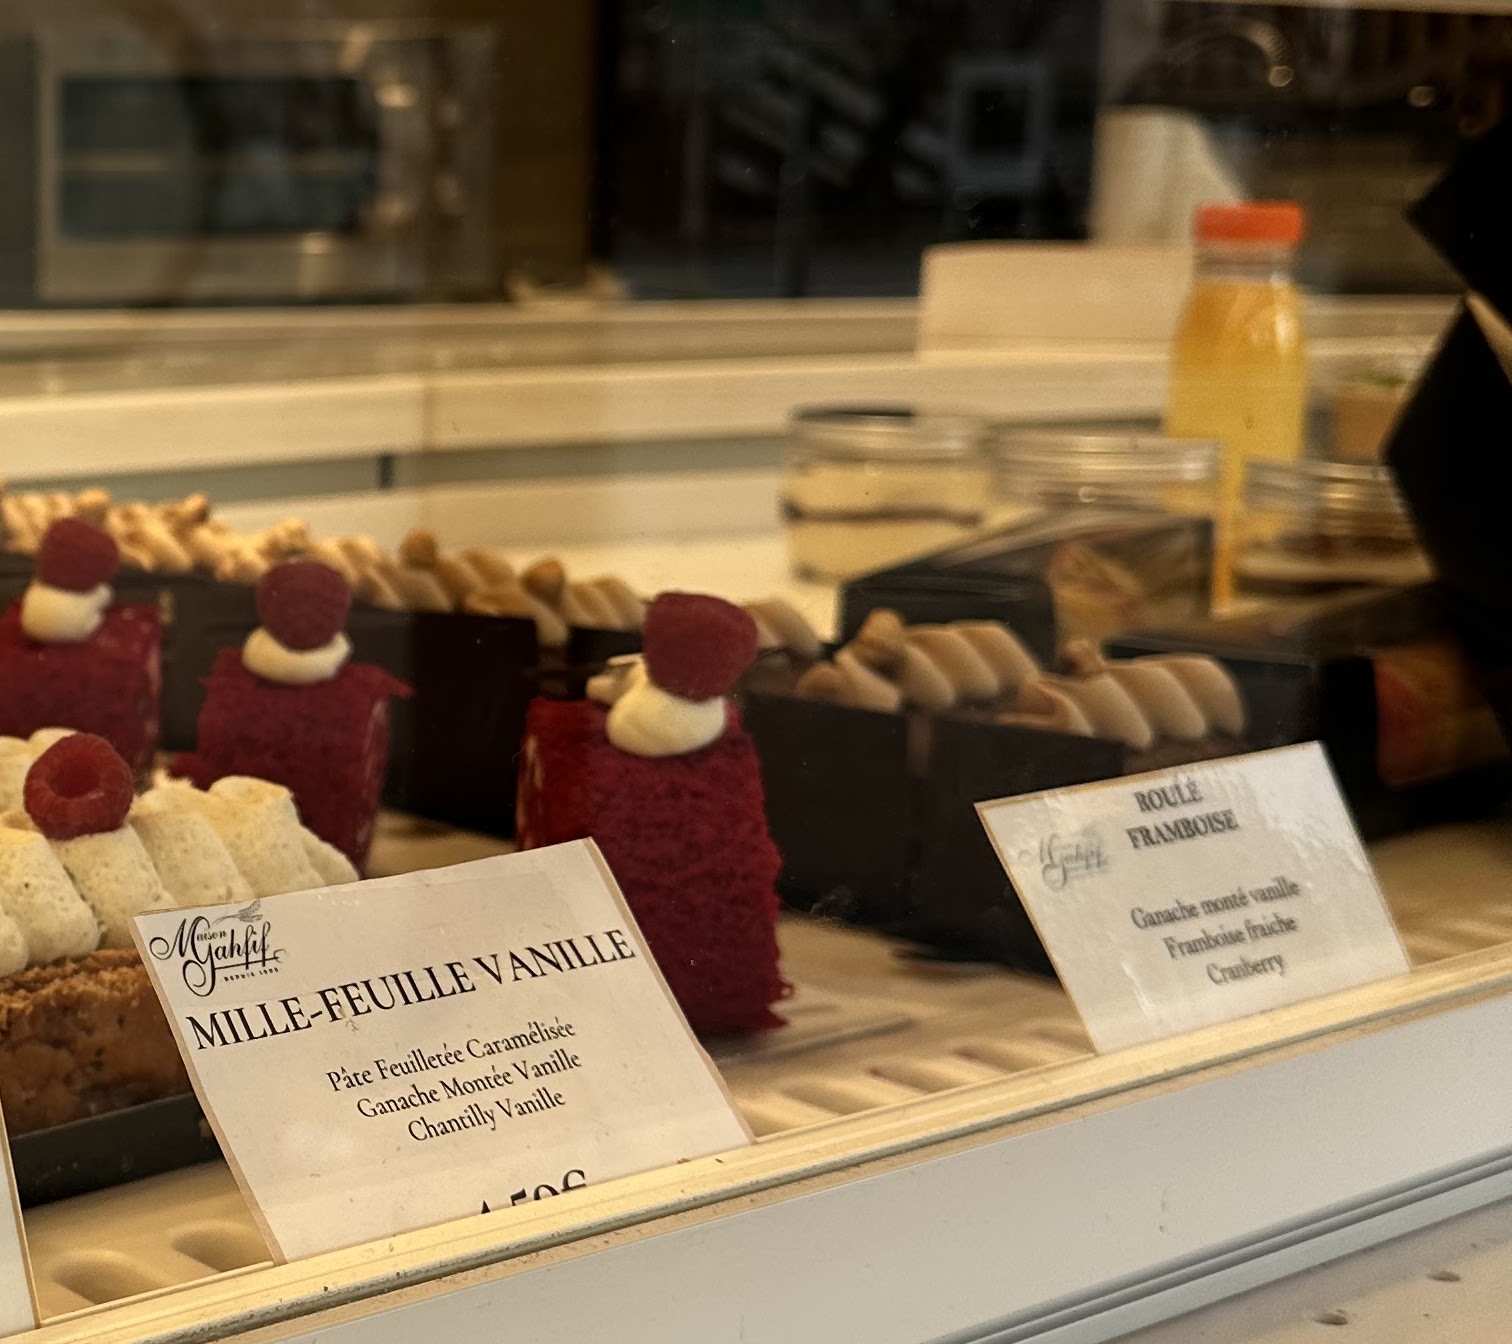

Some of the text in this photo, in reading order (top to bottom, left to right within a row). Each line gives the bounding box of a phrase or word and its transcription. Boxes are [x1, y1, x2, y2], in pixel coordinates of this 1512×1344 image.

[1126, 808, 1240, 849] FRAMBOISE
[1130, 898, 1200, 930] Ganache
[1248, 874, 1302, 903] vanille
[1162, 923, 1246, 960] Framboise
[185, 929, 637, 1051] MILLE-FEUILLE VANILLE
[1206, 954, 1285, 986] Cranberry
[326, 1016, 576, 1093] Pâte Feuilletée Caramélisée
[356, 1048, 583, 1118] Ganache Montée Vanille
[407, 1086, 566, 1142] Chantilly Vanille
